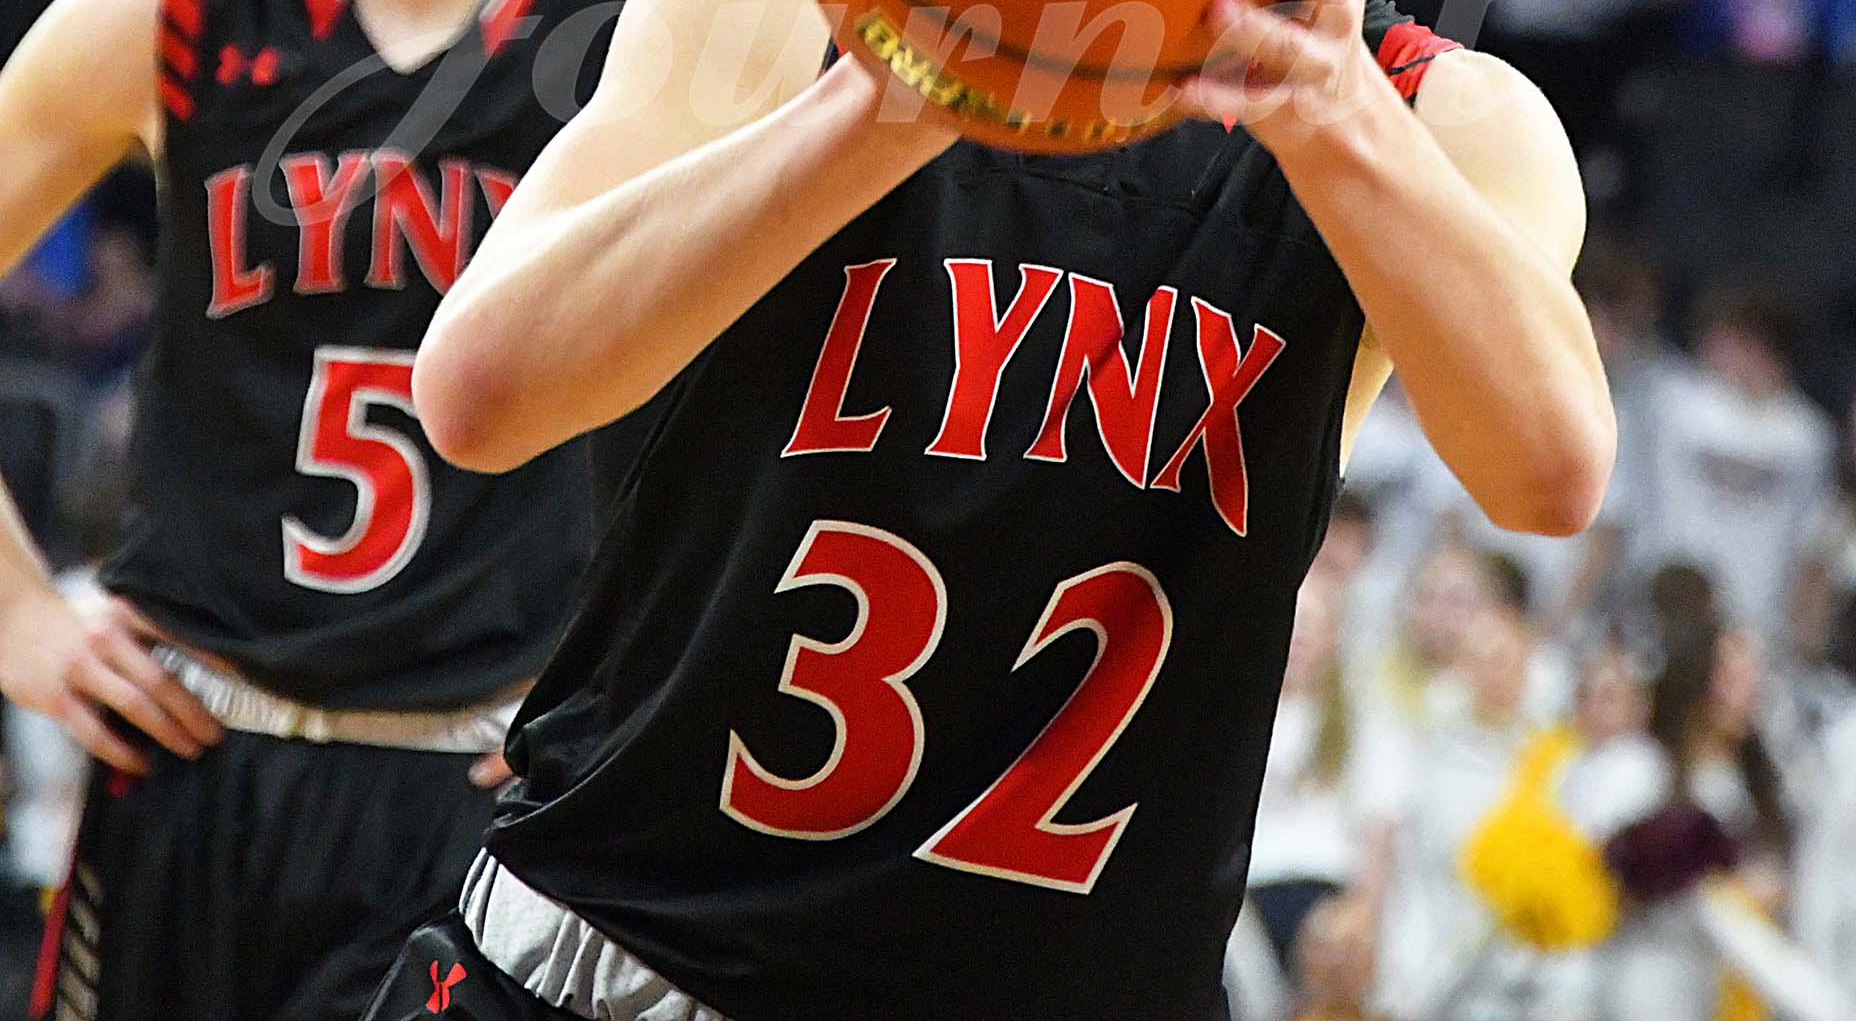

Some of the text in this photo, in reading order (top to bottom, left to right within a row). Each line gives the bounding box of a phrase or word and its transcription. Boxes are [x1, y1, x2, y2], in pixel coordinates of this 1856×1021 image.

[281, 345, 431, 595] 5
[781, 257, 1286, 537] LYNX
[719, 519, 1173, 895] 32
